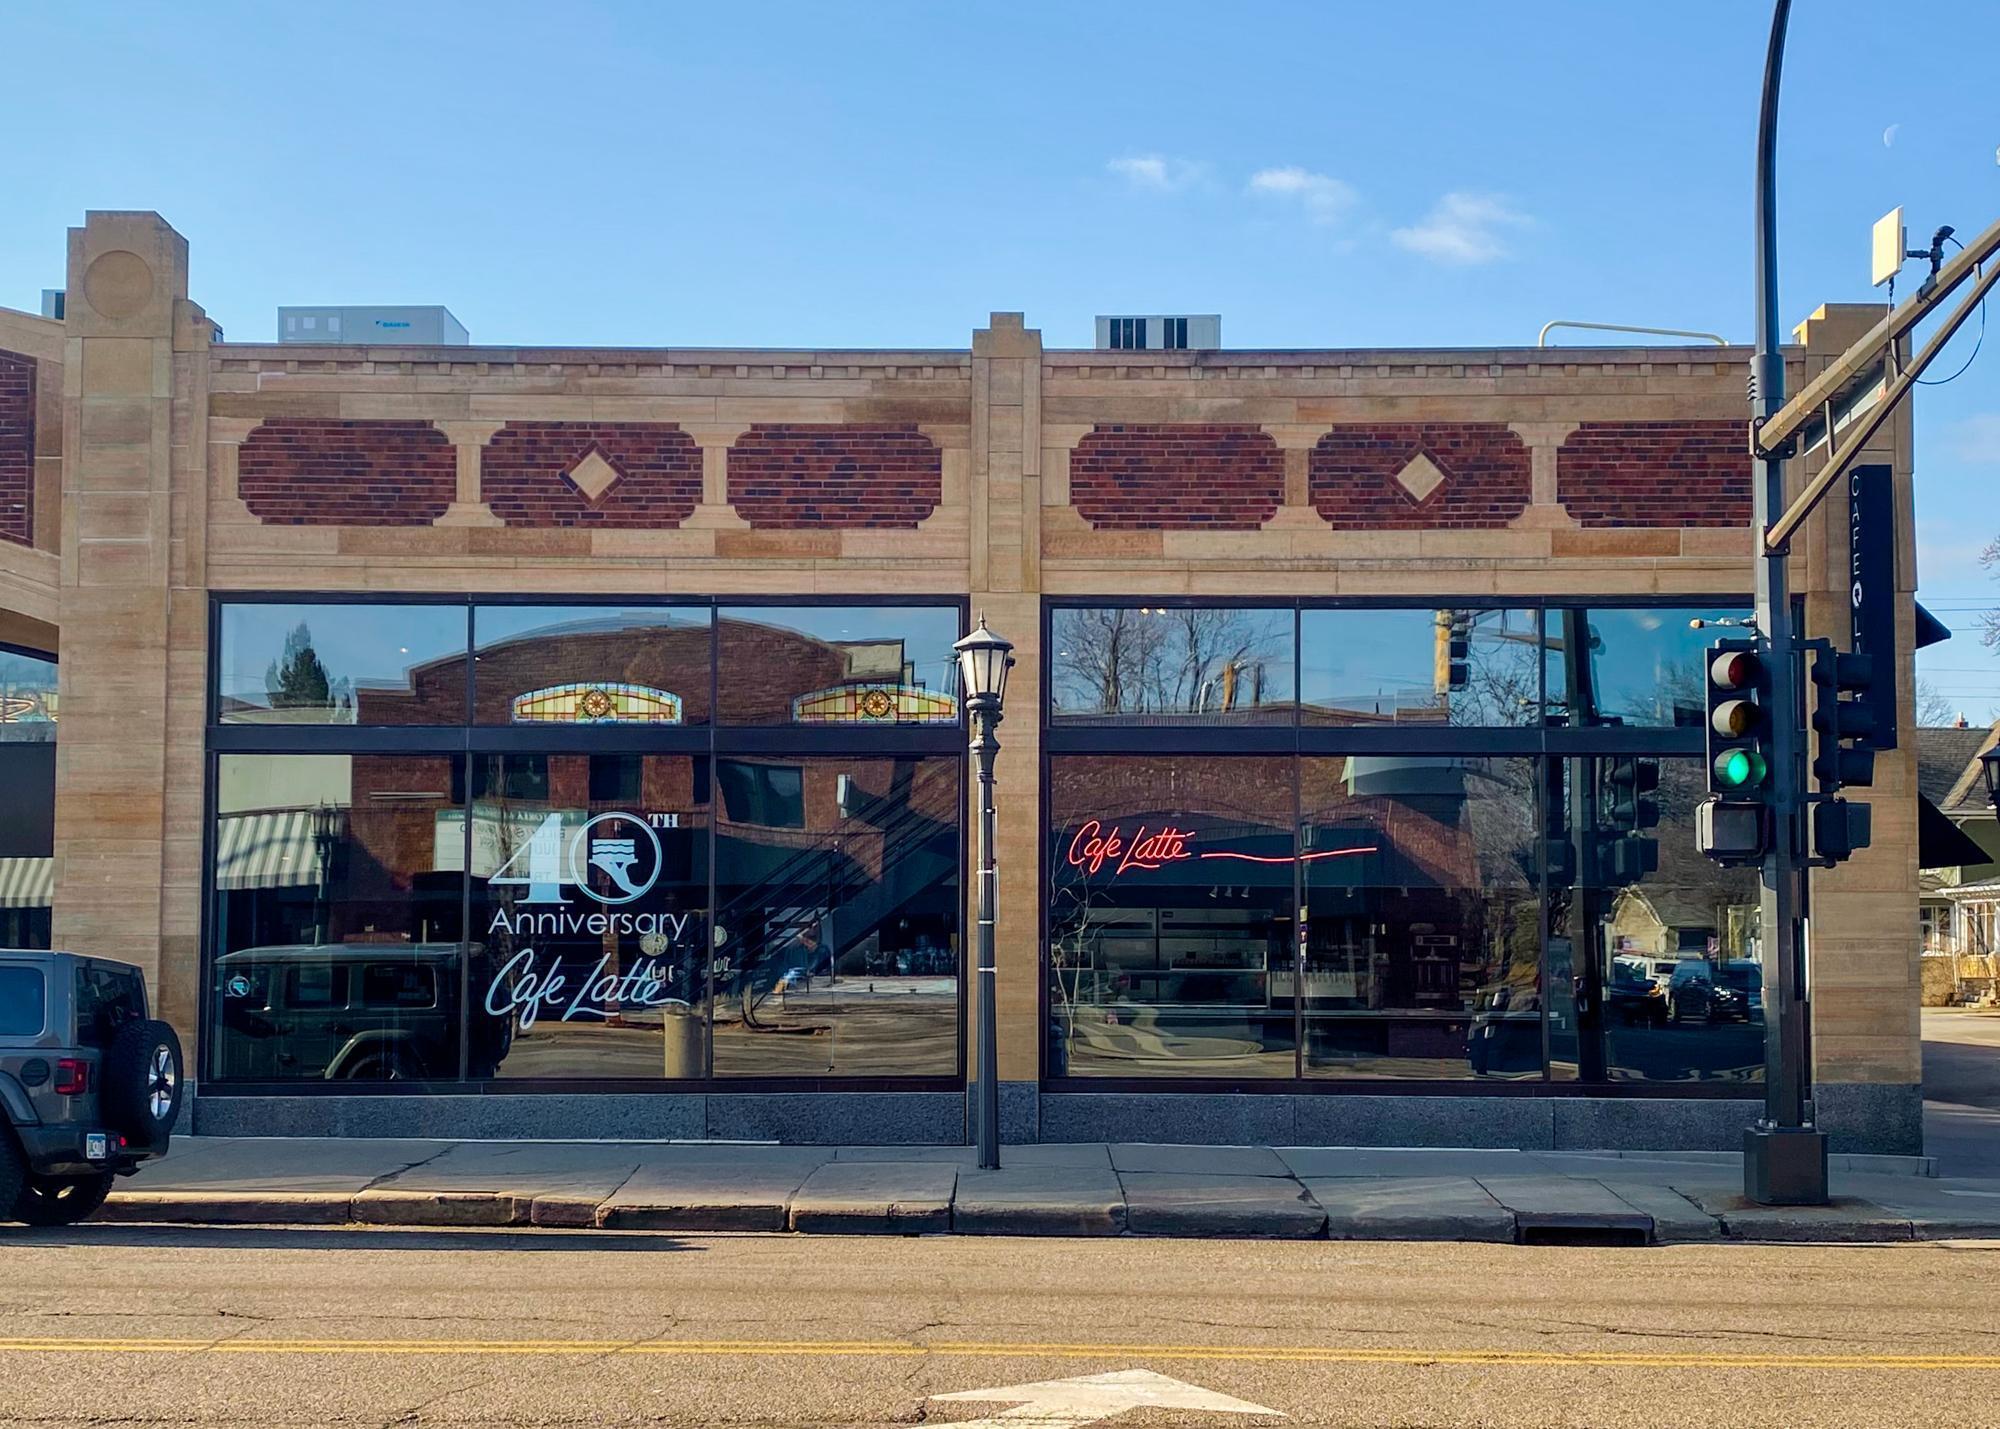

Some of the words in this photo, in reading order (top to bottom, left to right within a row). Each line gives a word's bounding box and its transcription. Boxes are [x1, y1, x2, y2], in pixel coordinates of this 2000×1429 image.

[1851, 474, 1861, 576] CAFE
[1068, 820, 1121, 874] Cafe
[488, 906, 689, 942] Anniversary
[485, 948, 566, 1030] Cafe
